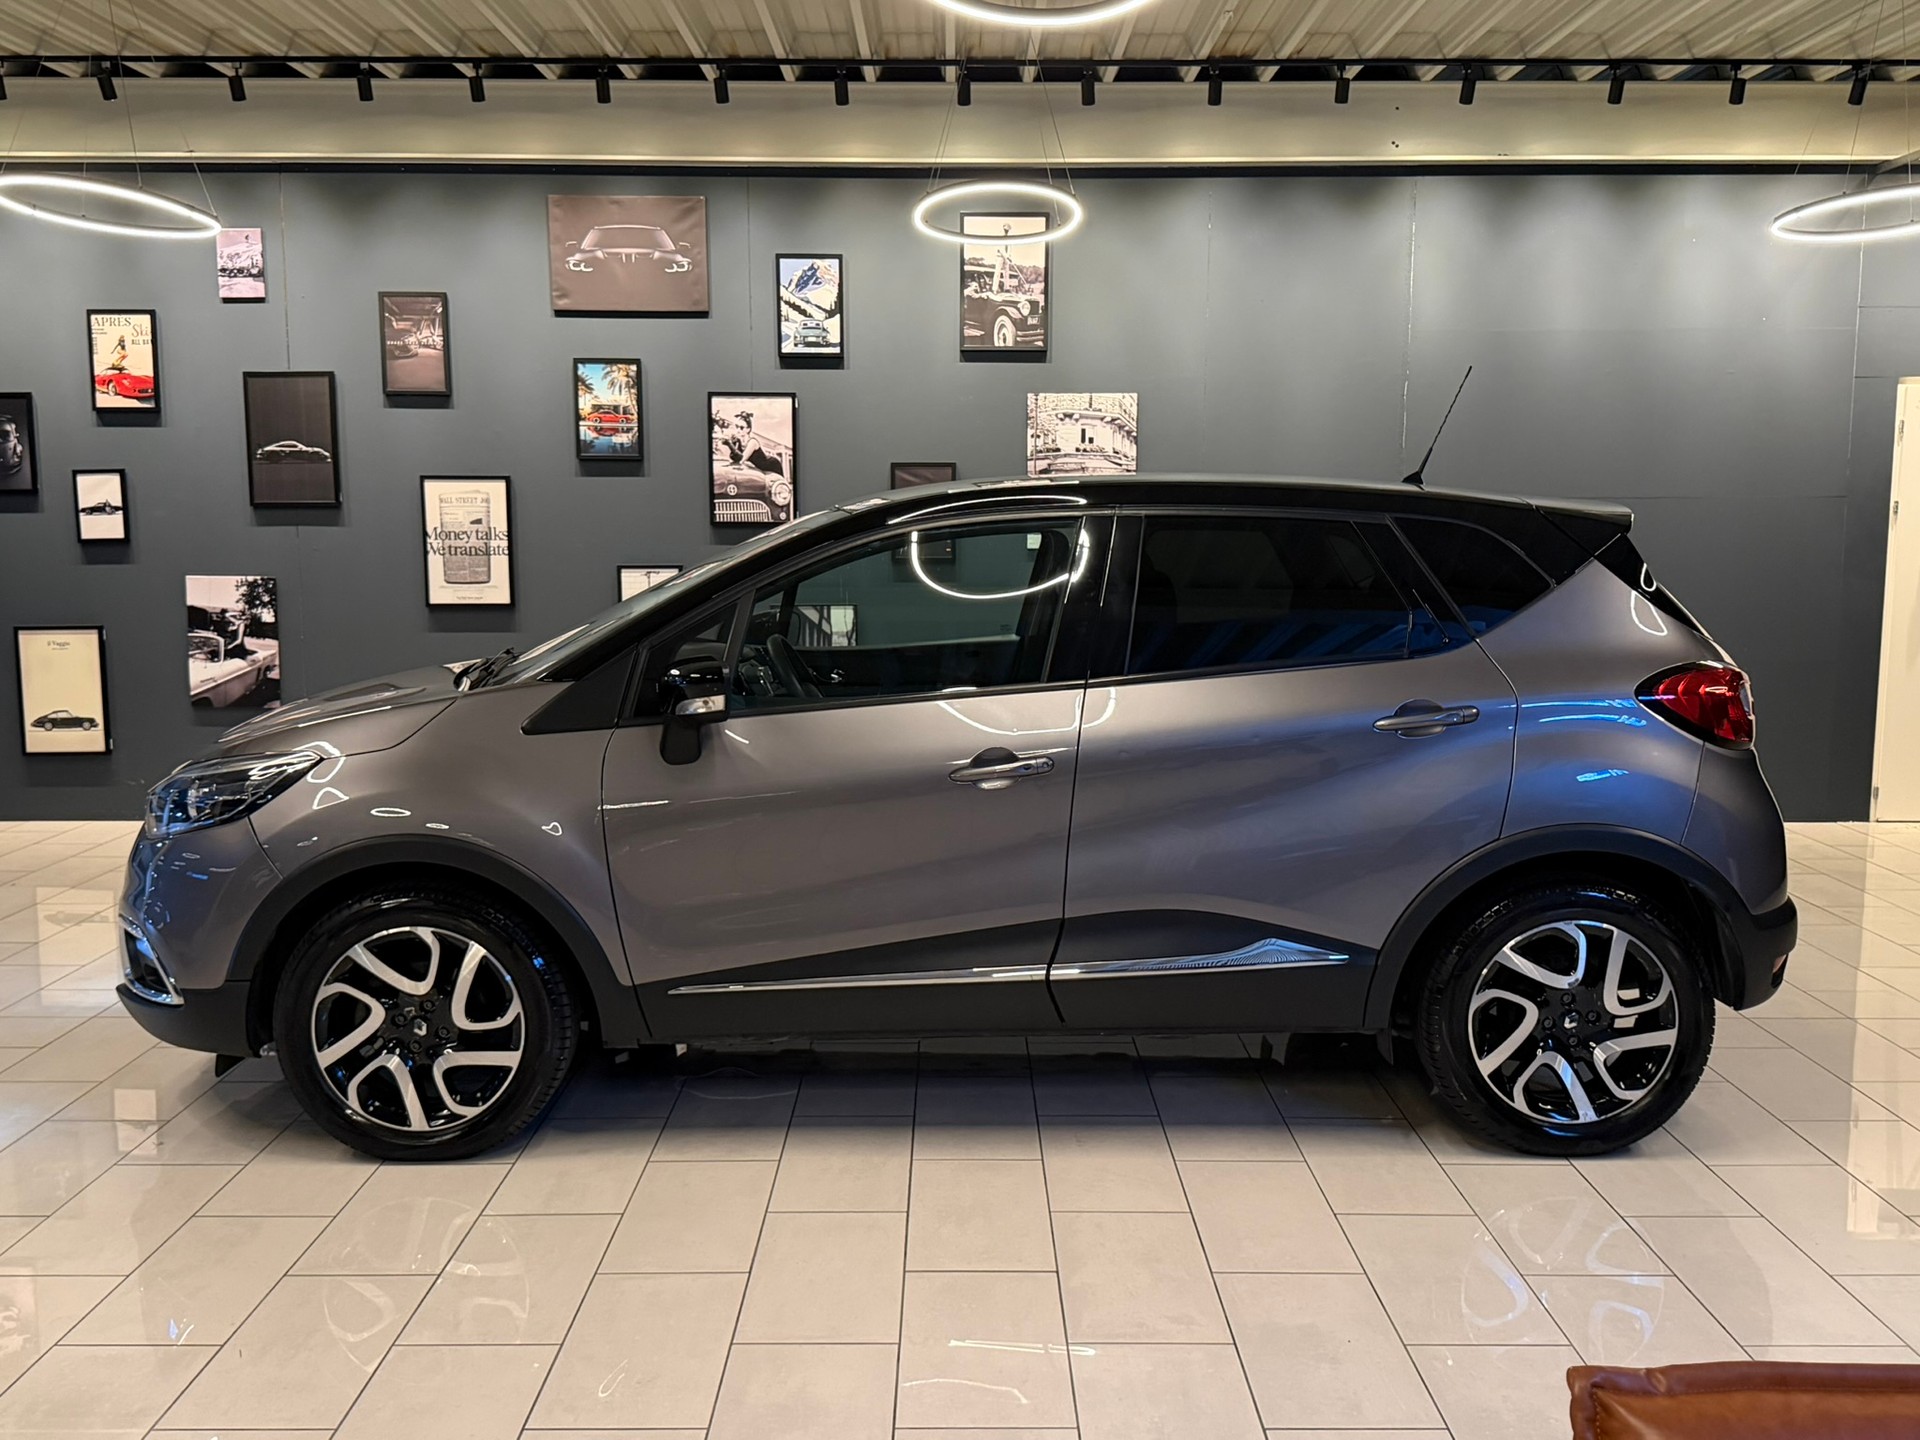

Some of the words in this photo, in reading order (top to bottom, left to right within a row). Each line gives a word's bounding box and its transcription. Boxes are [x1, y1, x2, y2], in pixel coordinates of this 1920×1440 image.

[426, 526, 473, 544] Money
[475, 526, 509, 541] talks
[447, 542, 509, 557] translate
